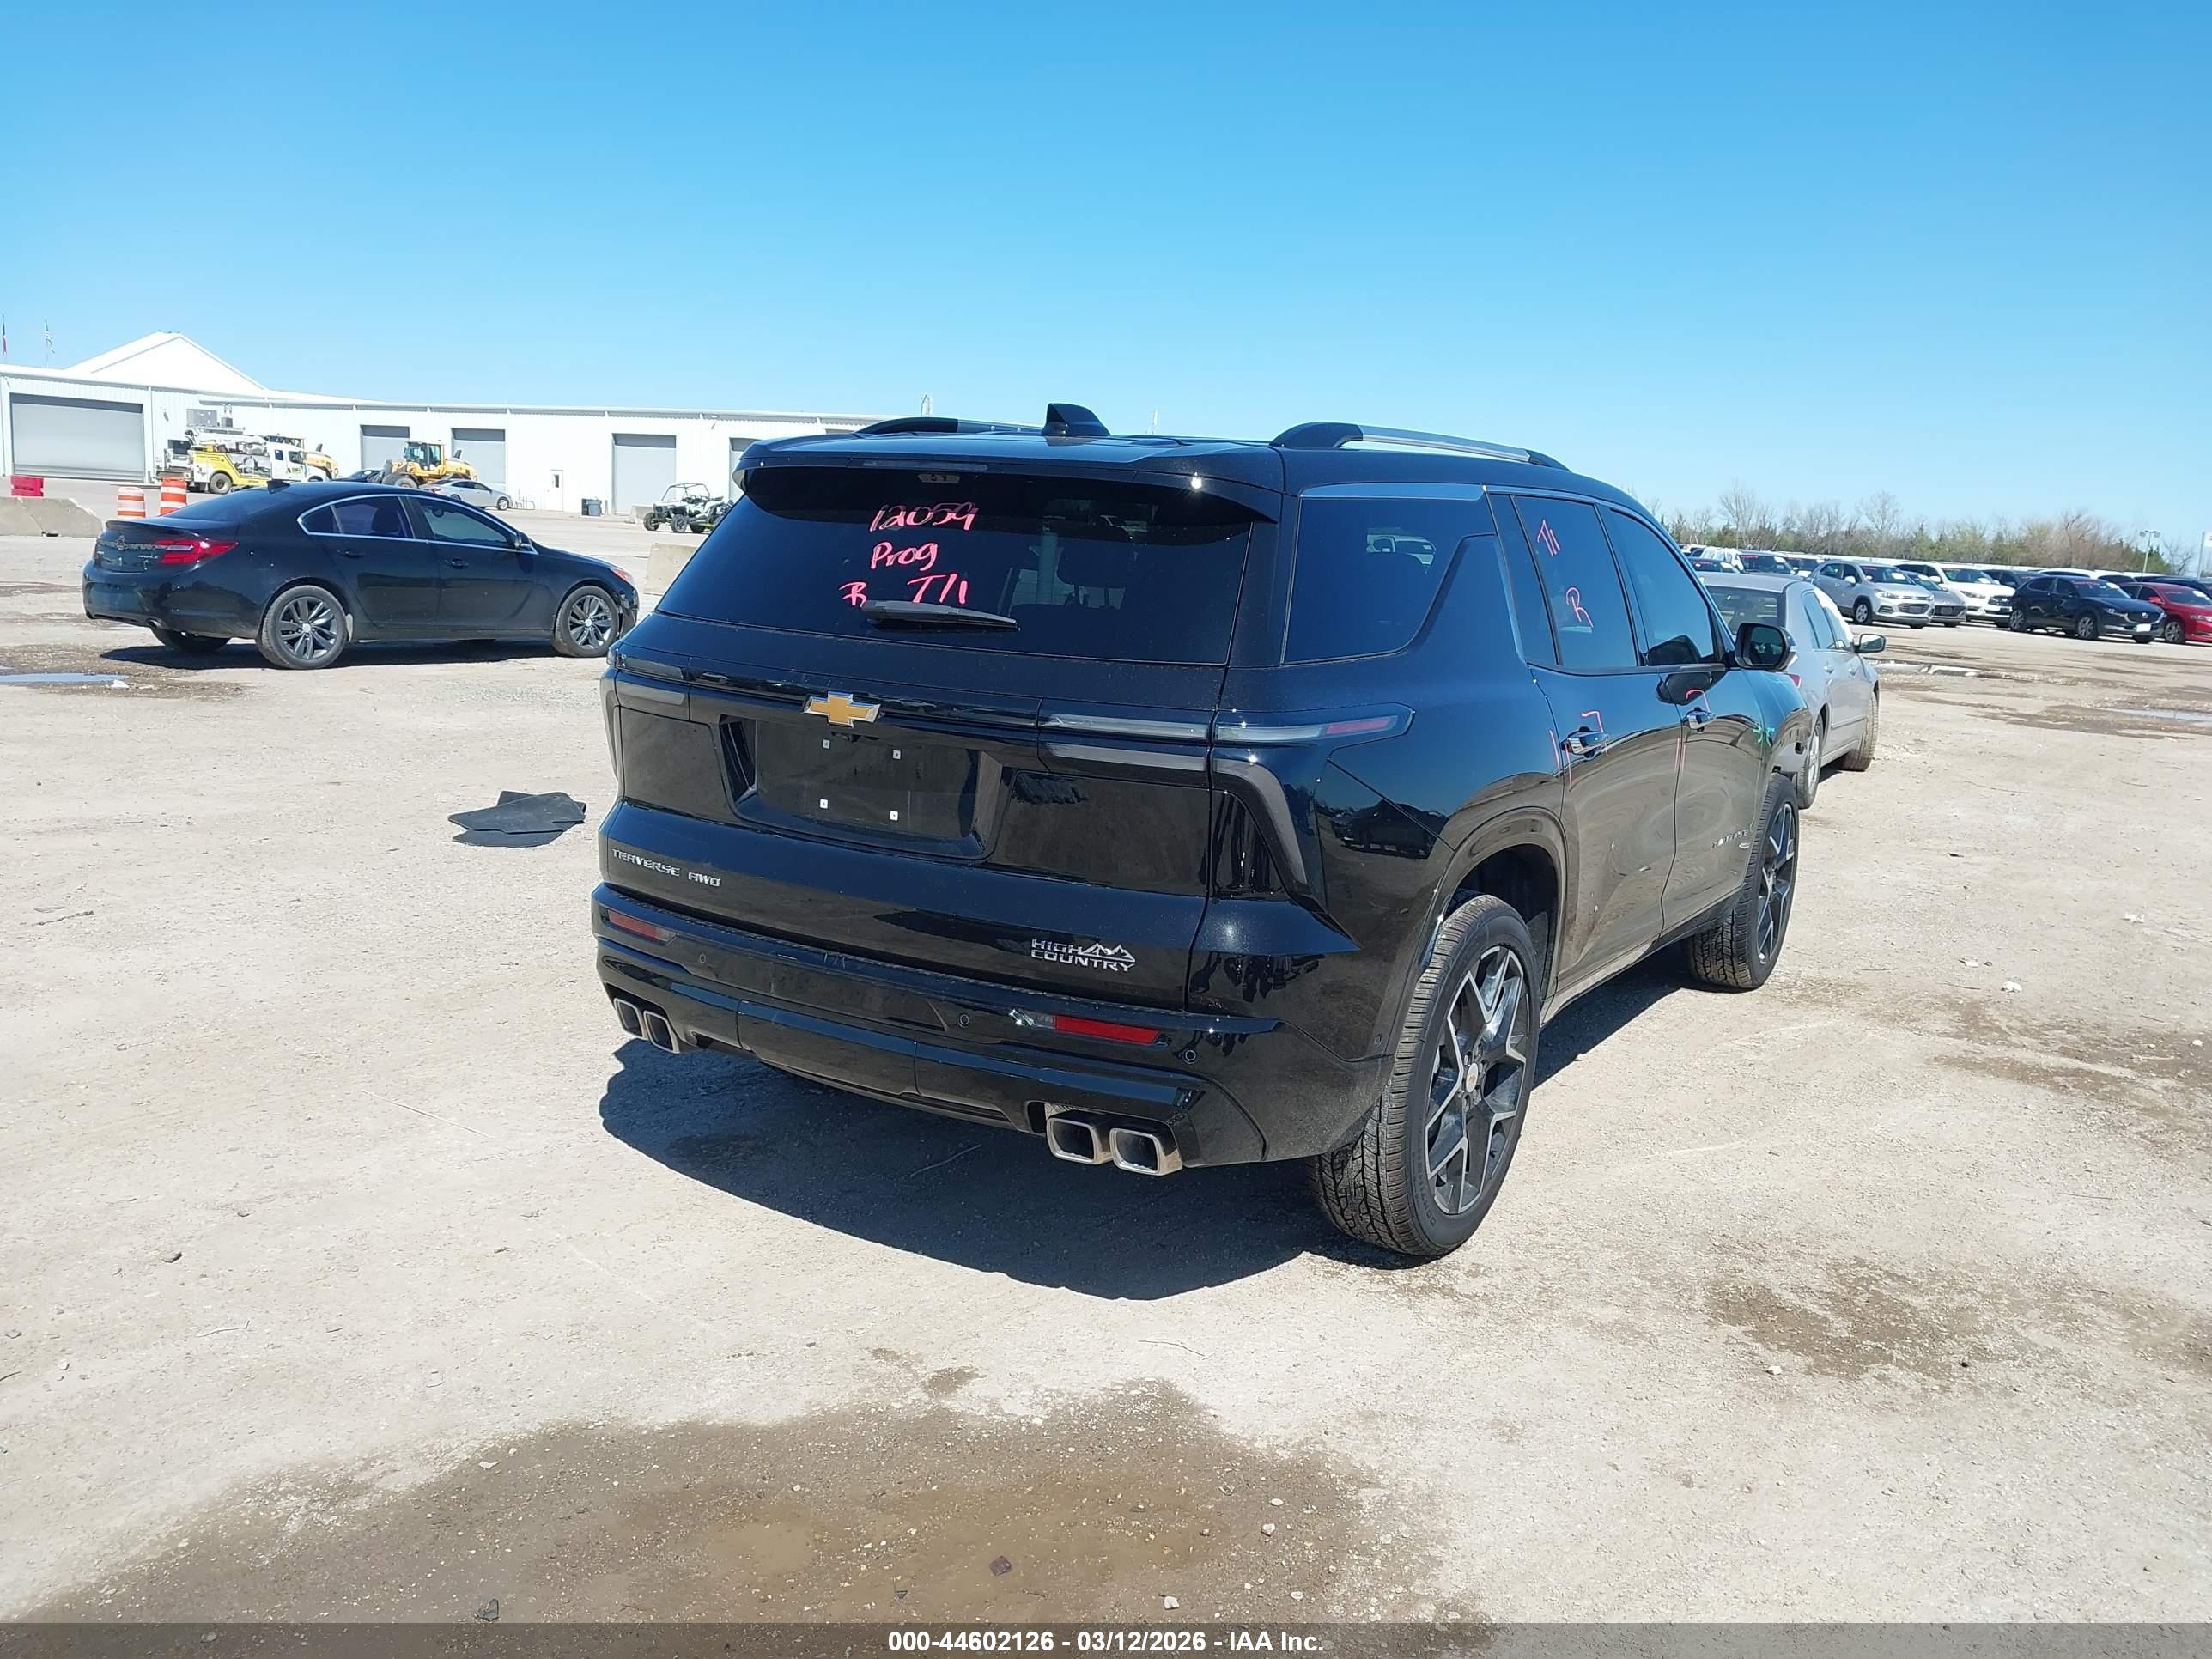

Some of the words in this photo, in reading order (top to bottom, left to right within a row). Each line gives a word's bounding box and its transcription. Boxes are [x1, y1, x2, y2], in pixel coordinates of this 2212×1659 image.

[870, 502, 979, 532] 12059
[612, 848, 681, 877] TRAVERSE
[688, 872, 721, 887] AWD
[1031, 939, 1082, 955] HIGH
[1031, 949, 1135, 972] COUNTRY
